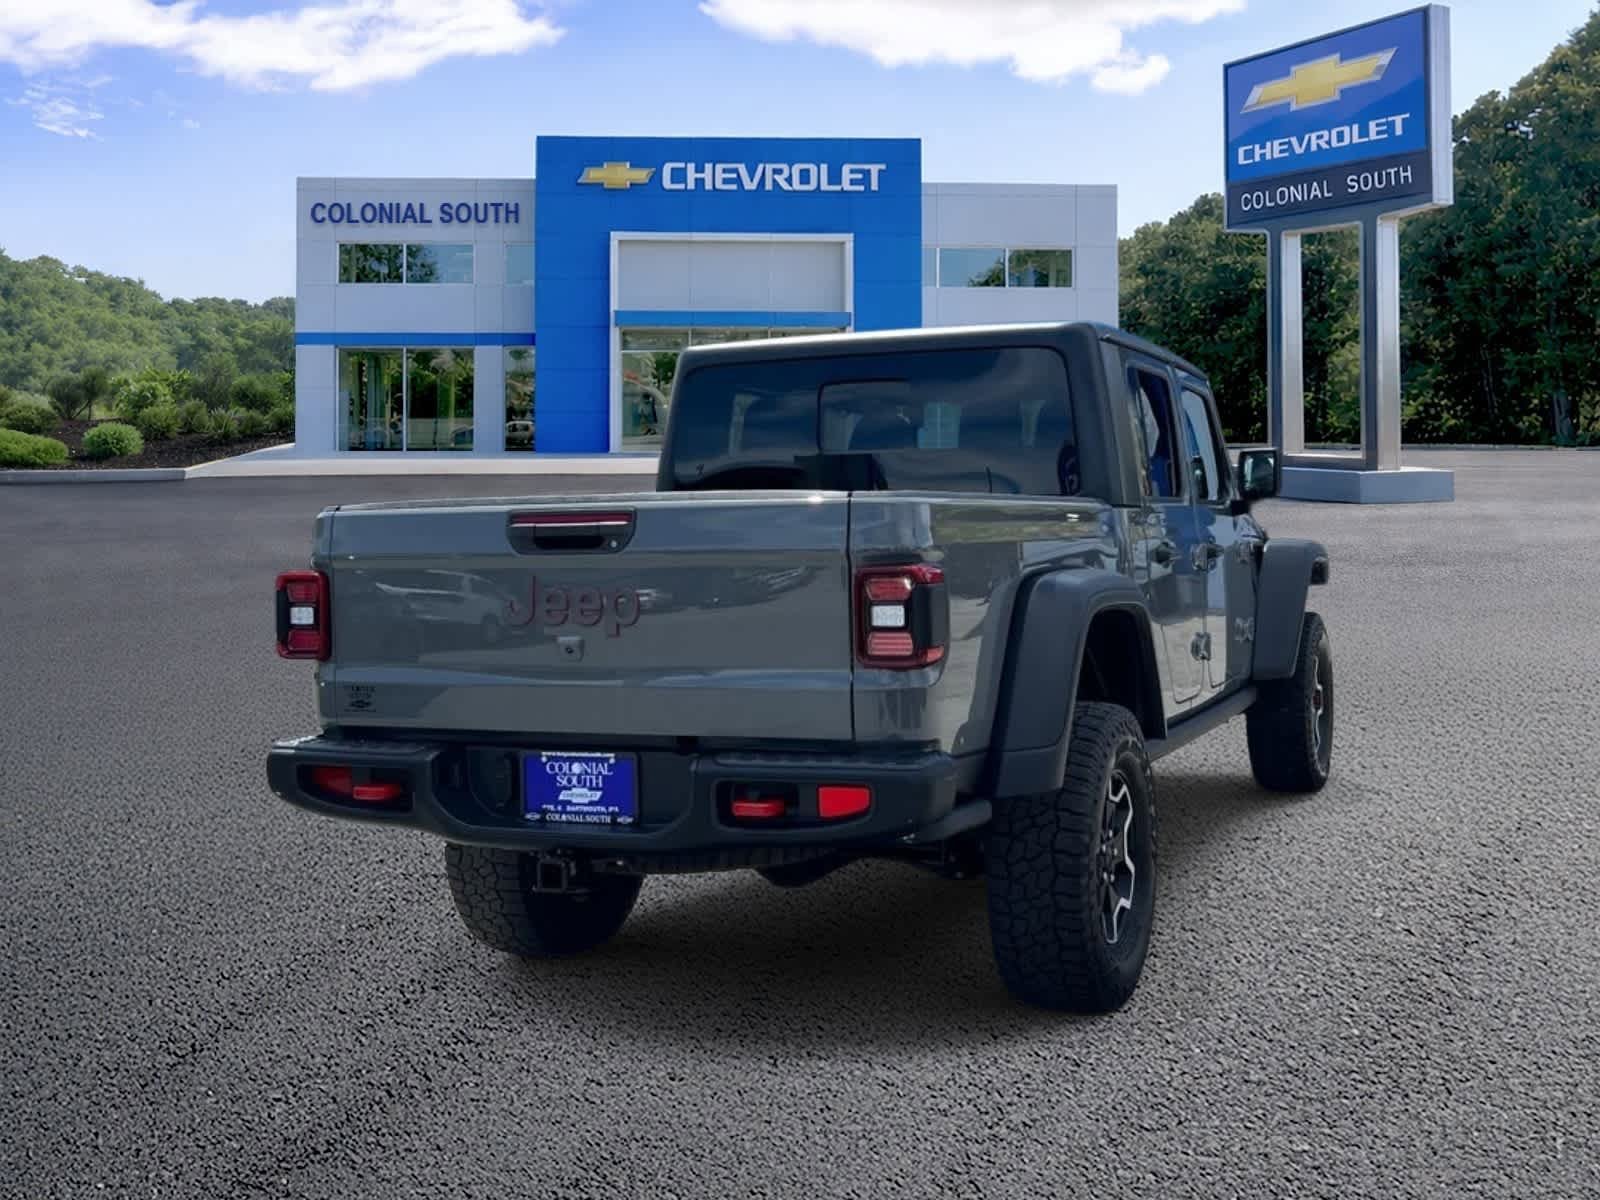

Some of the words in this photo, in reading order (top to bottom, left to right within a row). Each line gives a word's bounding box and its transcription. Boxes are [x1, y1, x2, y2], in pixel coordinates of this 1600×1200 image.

[1237, 113, 1410, 165] CHEVROLET
[662, 162, 887, 192] CHEVROLET
[1240, 180, 1333, 211] COLONIAL
[1346, 165, 1412, 193] SOUTH
[310, 202, 433, 224] COLONIAL
[439, 202, 520, 224] SOUTH
[503, 576, 641, 639] Jeep
[545, 761, 613, 775] COLONIAL
[556, 775, 603, 788] SOUTH
